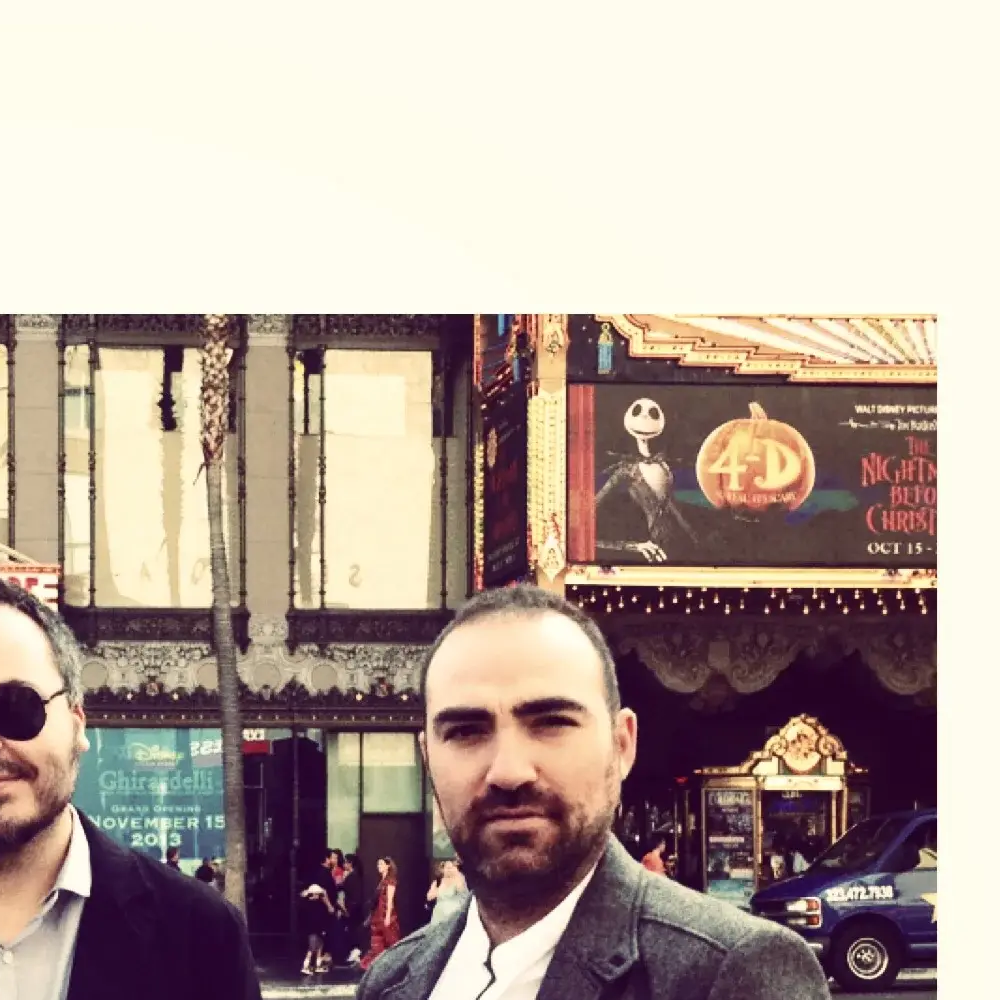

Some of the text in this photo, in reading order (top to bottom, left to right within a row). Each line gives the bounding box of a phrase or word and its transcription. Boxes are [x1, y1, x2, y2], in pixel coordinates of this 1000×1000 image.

[707, 430, 801, 491] 4-D
[867, 542, 900, 555] OCT
[907, 542, 923, 555] 15
[100, 769, 214, 791] Ghirardelli
[205, 814, 226, 829] 15
